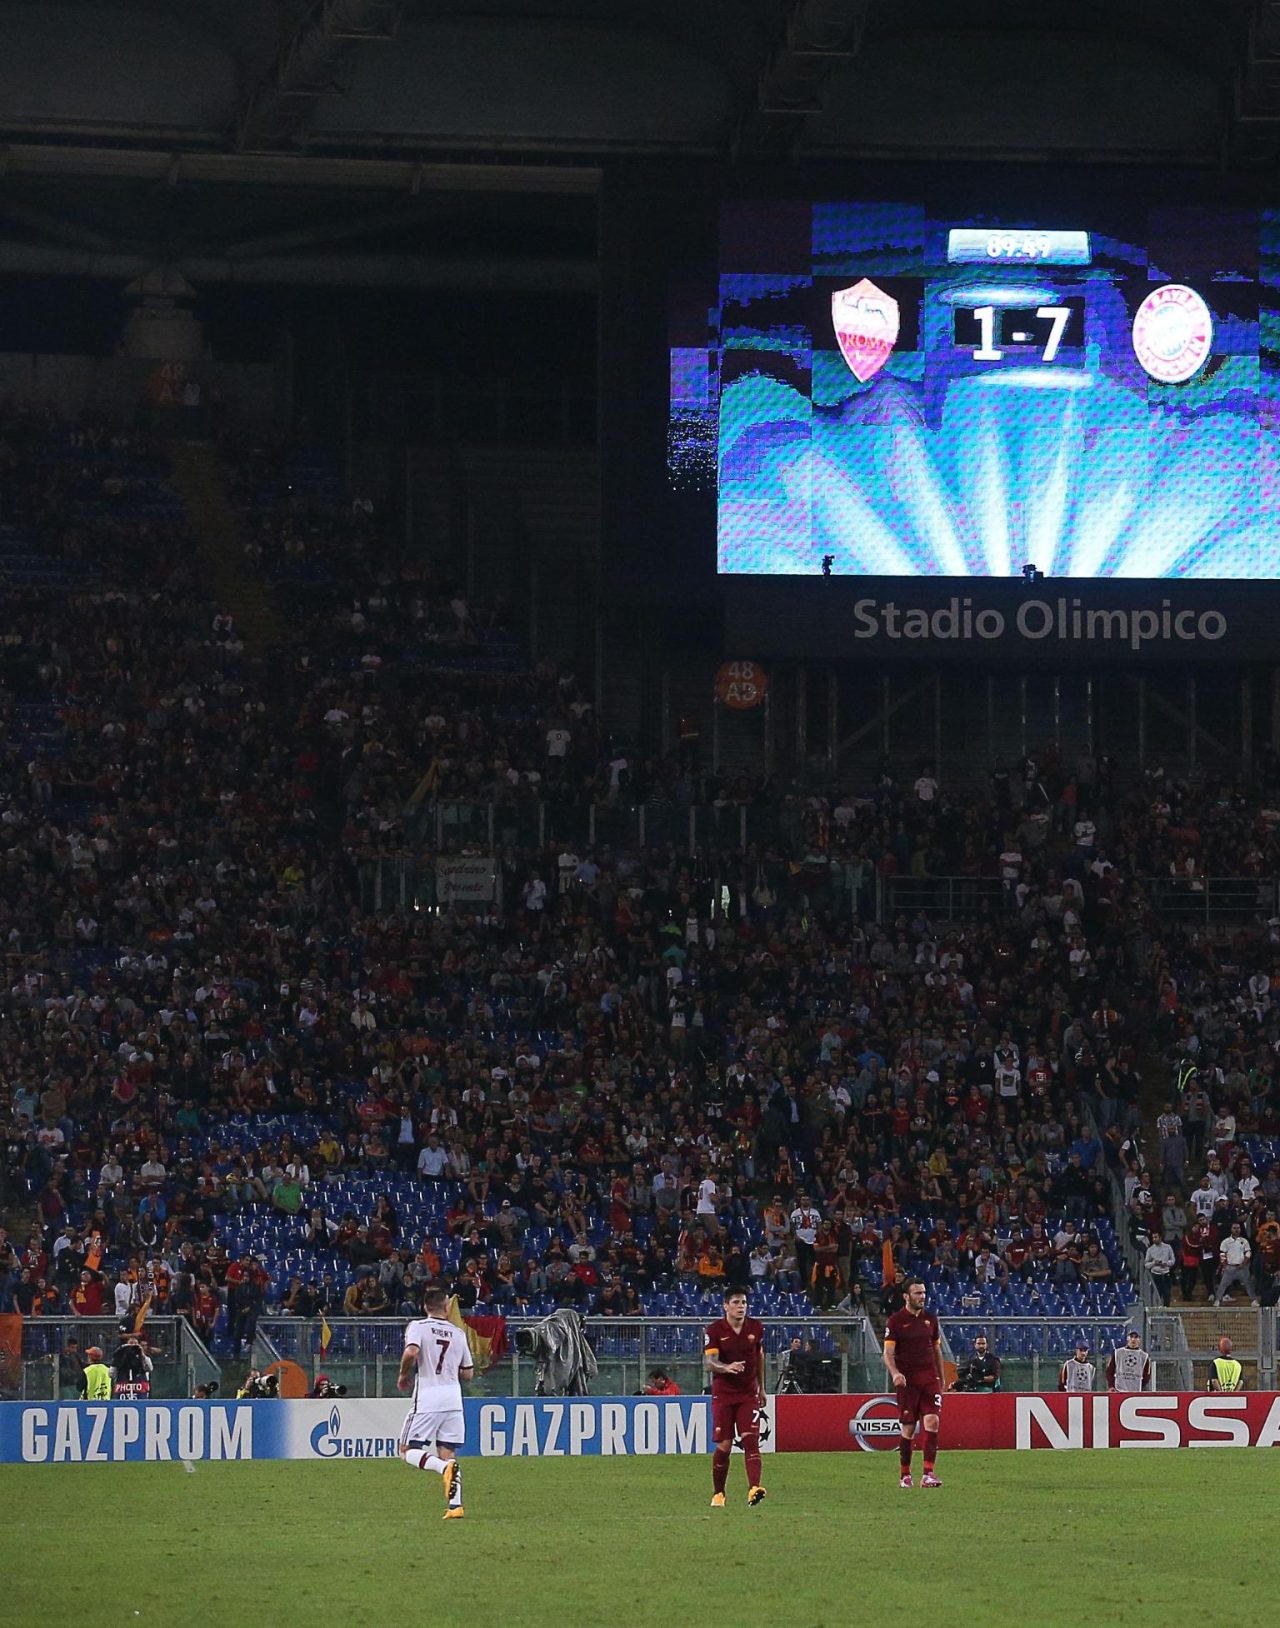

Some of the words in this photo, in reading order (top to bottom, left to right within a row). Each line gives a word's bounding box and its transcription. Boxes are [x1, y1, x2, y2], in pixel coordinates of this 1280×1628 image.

[854, 597, 1006, 640] Stadio
[1016, 598, 1228, 650] Olimpico
[728, 661, 754, 680] 48
[727, 682, 756, 702] AD
[435, 1339, 450, 1375] 7
[115, 1383, 142, 1392] PHOTO
[752, 1409, 760, 1423] 7
[21, 1405, 253, 1462] GAZPROM
[479, 1402, 708, 1457] GAZPROM
[856, 1421, 902, 1432] NISSA
[343, 1438, 401, 1457] GAZPR
